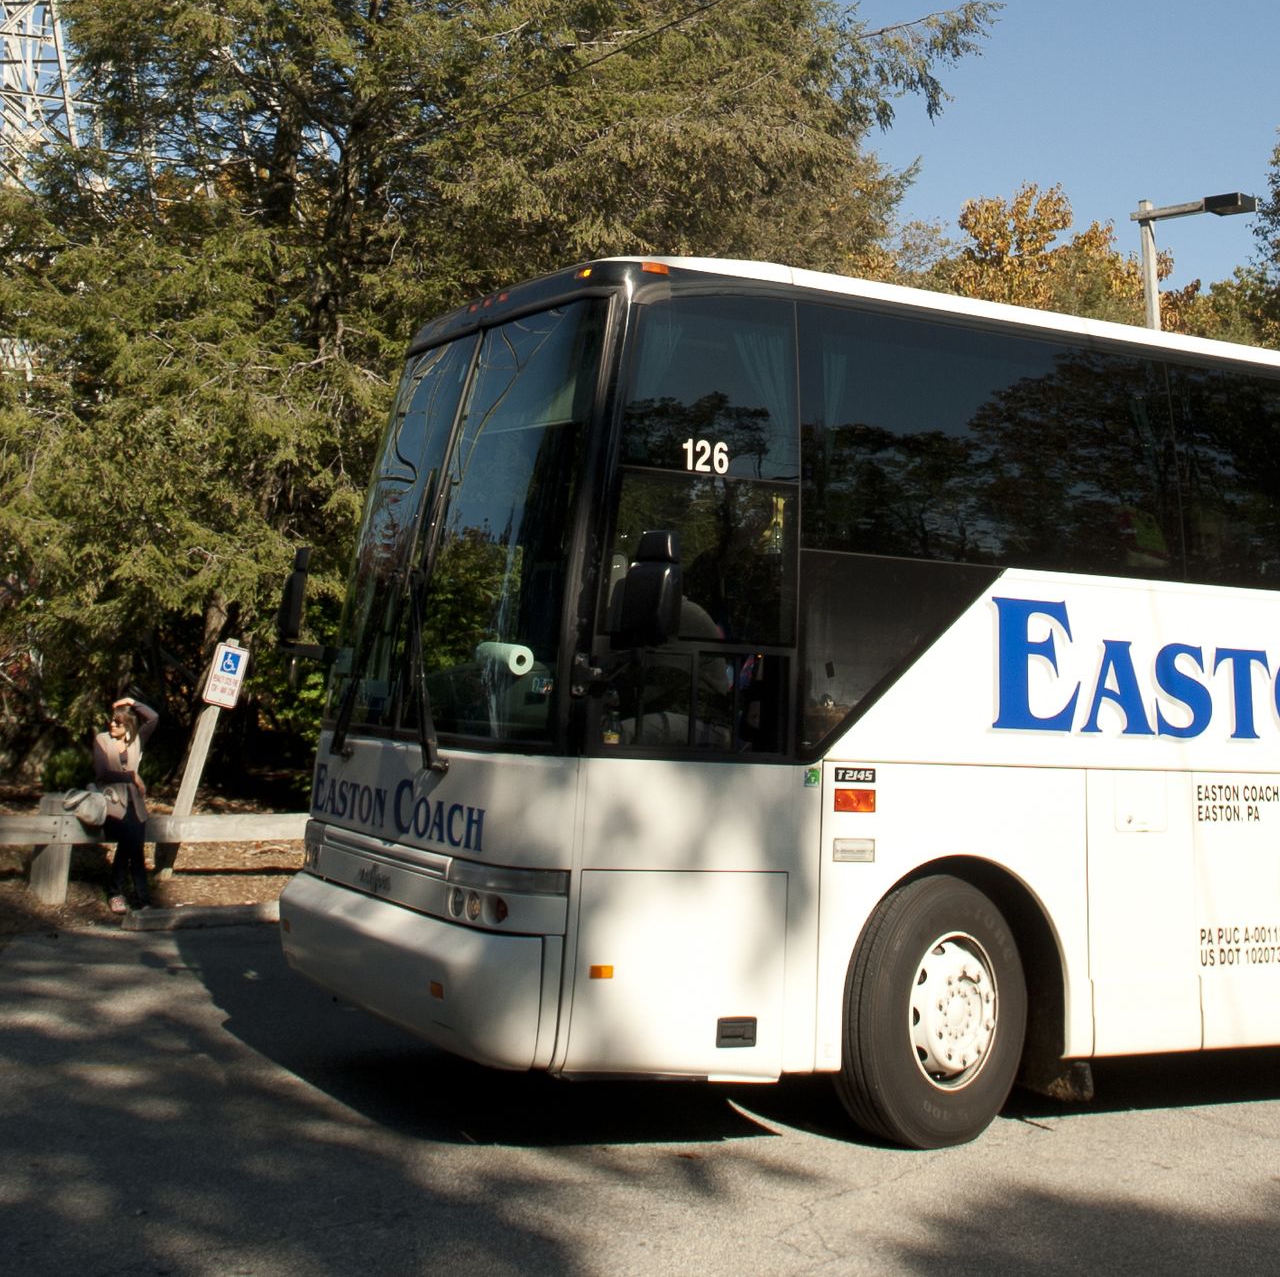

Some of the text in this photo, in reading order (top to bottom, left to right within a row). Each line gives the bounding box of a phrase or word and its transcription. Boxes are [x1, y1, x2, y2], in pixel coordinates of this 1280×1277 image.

[682, 437, 730, 475] 126
[1197, 785, 1239, 801] EASTON
[1243, 785, 1279, 802] COACH
[313, 764, 486, 852] EASTON COACH
[1247, 805, 1260, 822] PA
[1200, 928, 1214, 945] PA
[1217, 927, 1240, 945] PUC
[1200, 949, 1215, 967] US
[1219, 947, 1241, 966] DOT
